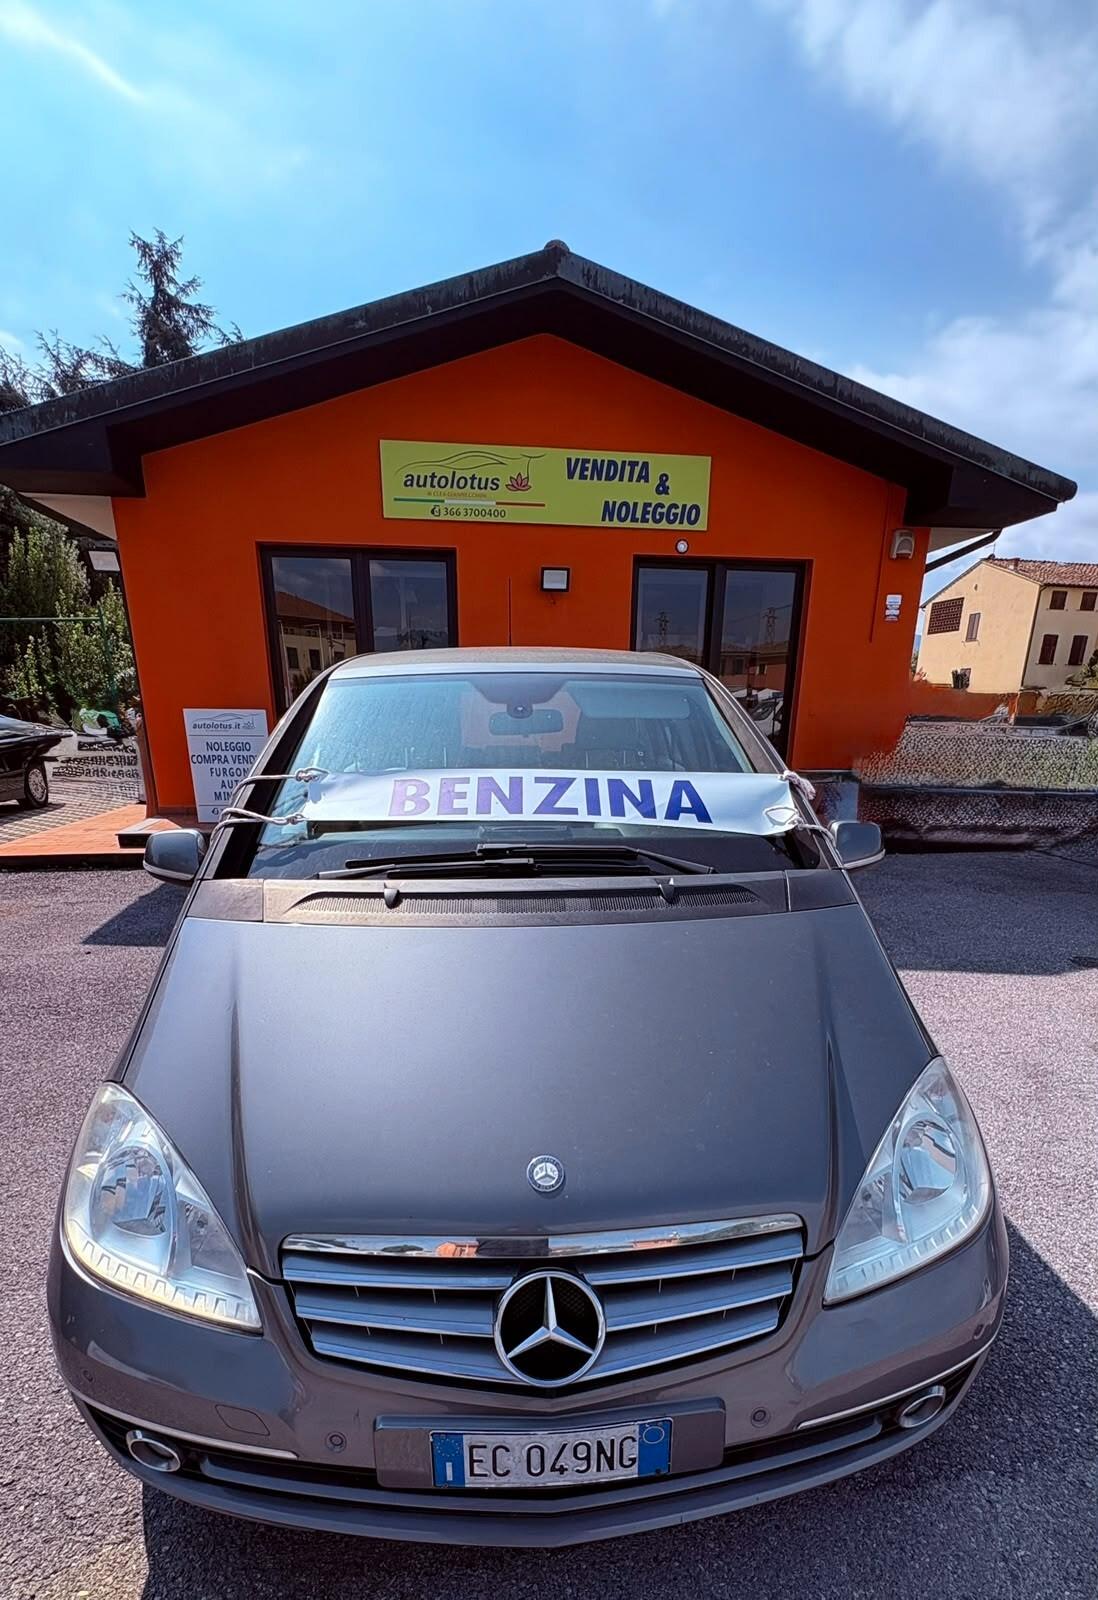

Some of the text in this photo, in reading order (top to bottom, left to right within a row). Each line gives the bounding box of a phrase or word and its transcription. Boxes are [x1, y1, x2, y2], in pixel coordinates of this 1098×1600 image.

[403, 470, 501, 491] autolotus
[566, 457, 670, 495] VENDITA &
[443, 507, 506, 518] 366 3700400
[601, 500, 701, 526] NOLEGGIO
[192, 721, 241, 730] autolotus.it
[206, 741, 252, 752] NOLEGGIO
[191, 754, 258, 765] COMPRA VEND
[388, 776, 714, 824] BENZINA
[469, 1444, 511, 1477] EC
[526, 1436, 637, 1477] 049NG
